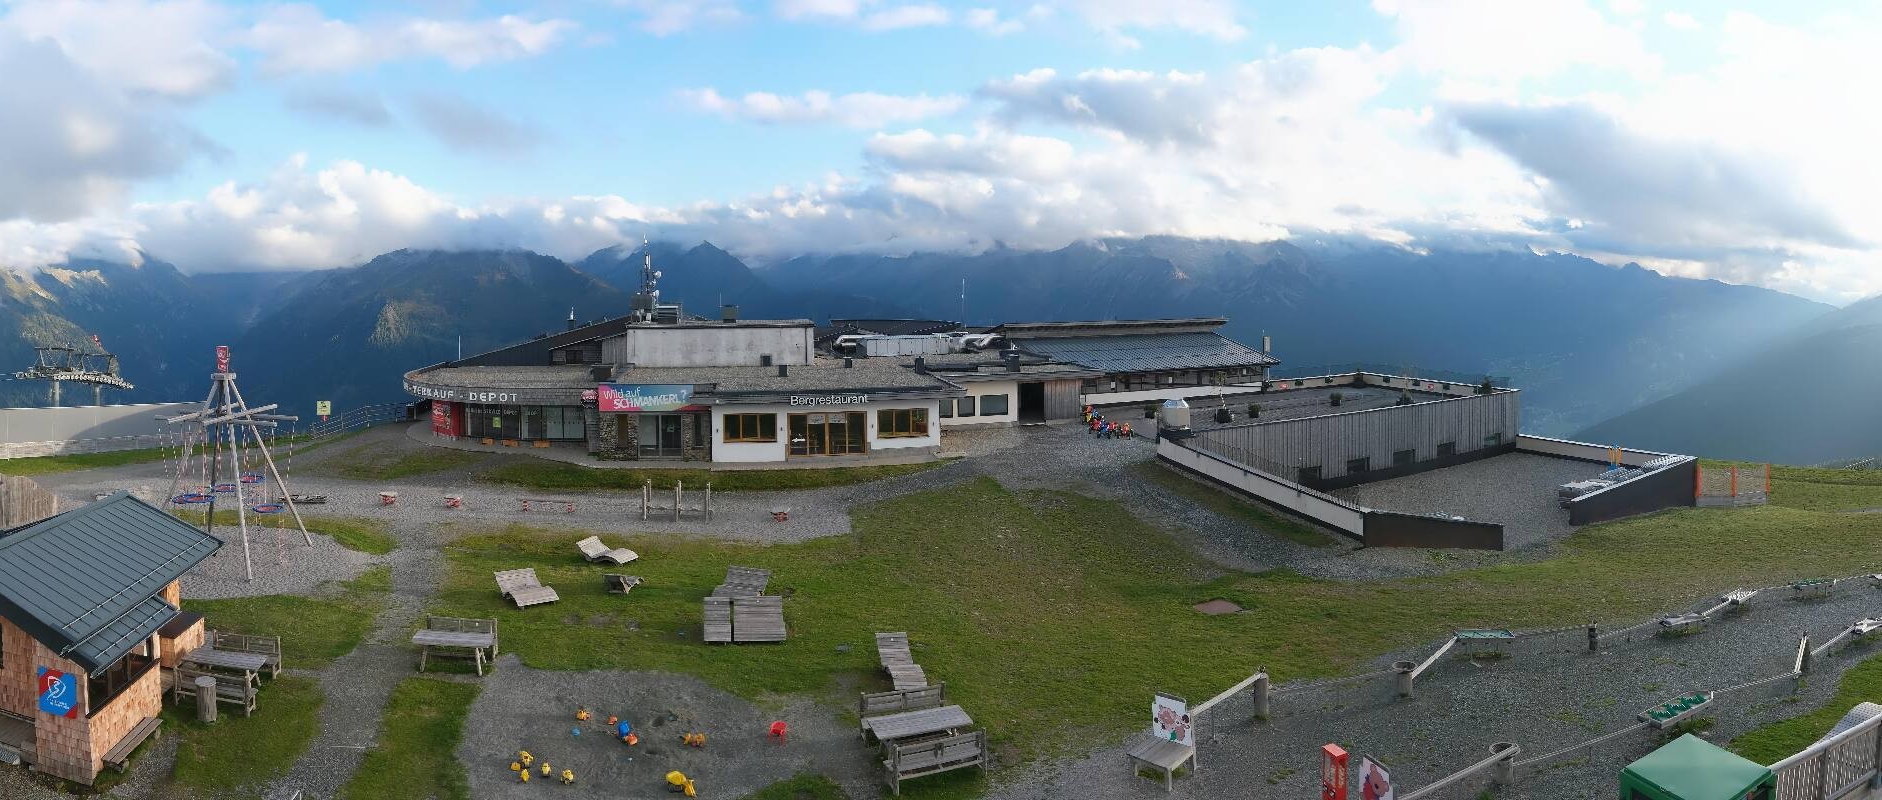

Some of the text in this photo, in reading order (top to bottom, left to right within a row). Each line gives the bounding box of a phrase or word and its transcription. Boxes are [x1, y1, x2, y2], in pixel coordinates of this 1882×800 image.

[469, 392, 518, 402] DEPOT
[603, 388, 624, 400] Wild
[626, 387, 641, 397] auf
[790, 394, 868, 406] Bergrestaurant
